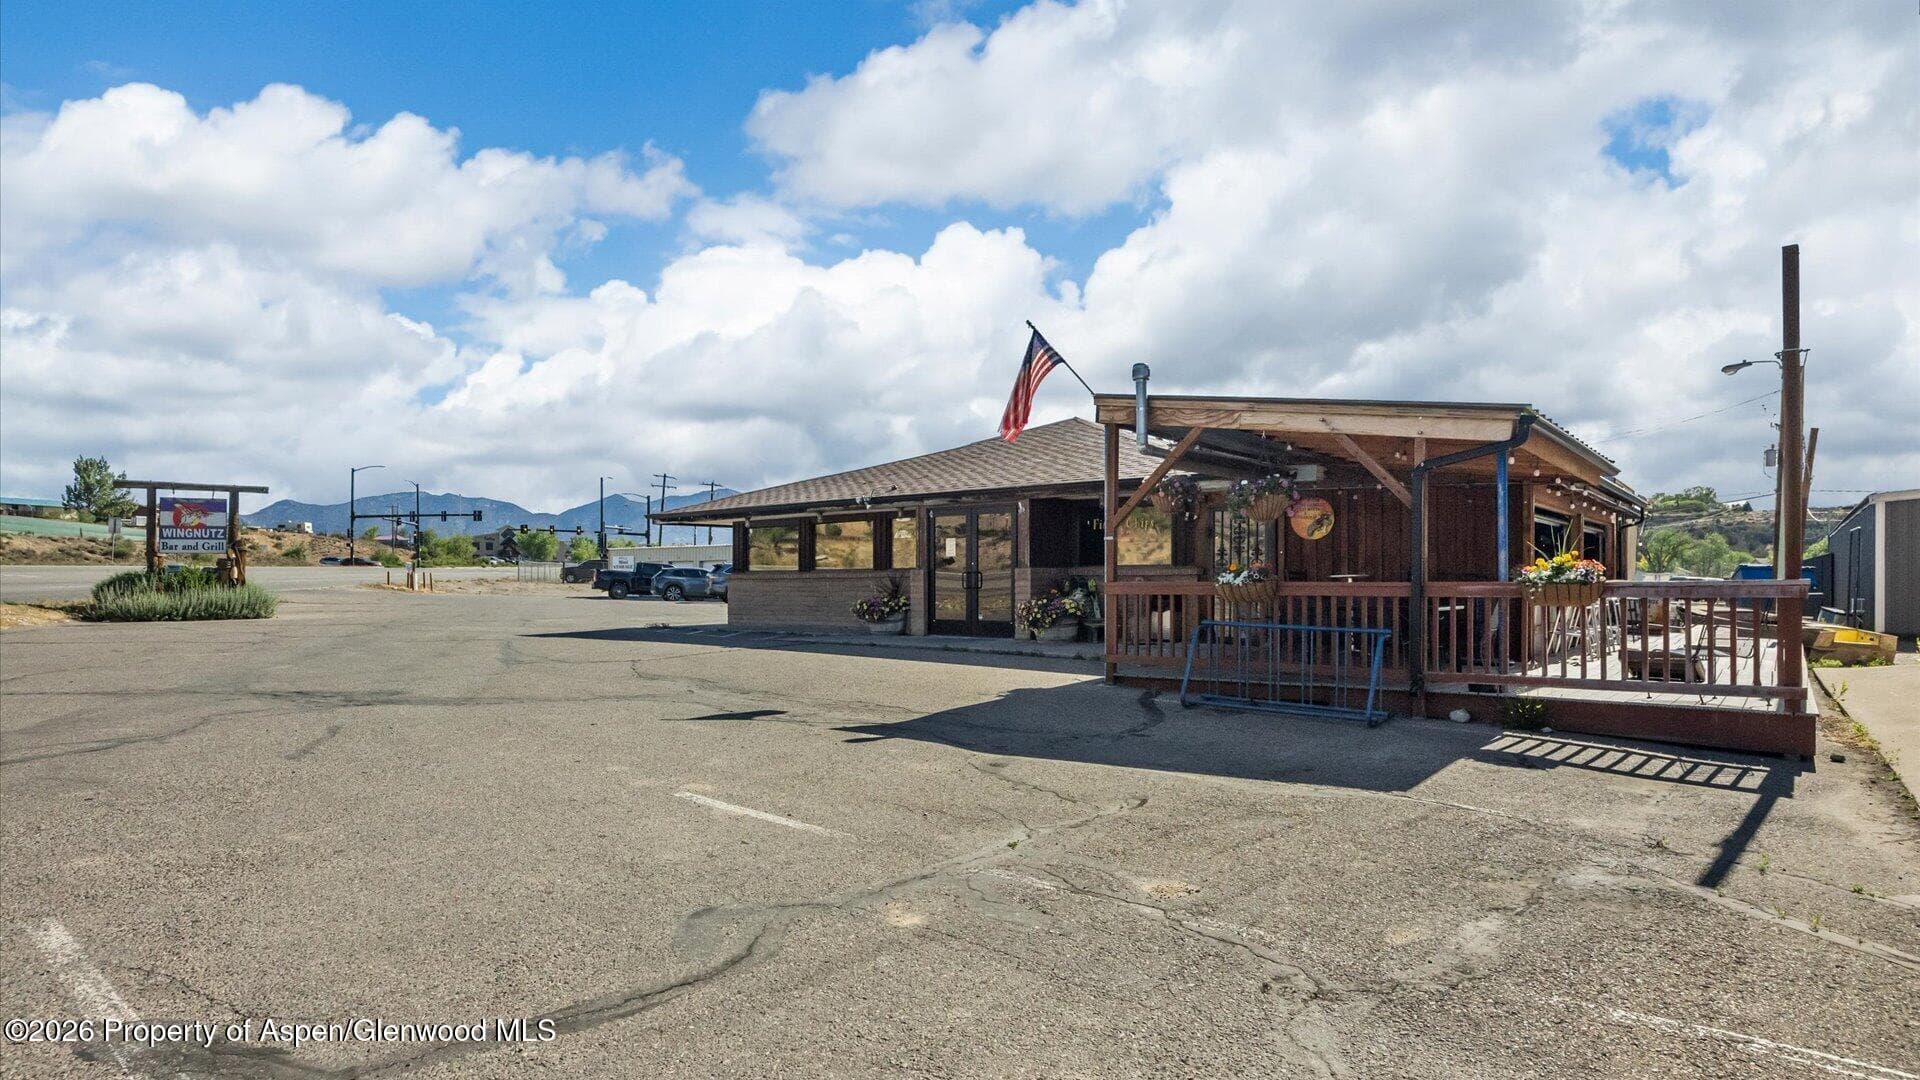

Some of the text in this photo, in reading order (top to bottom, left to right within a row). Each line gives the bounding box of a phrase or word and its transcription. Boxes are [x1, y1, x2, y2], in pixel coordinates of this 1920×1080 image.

[162, 528, 225, 539] WINGNUTZ
[161, 541, 224, 551] Bar and Grill
